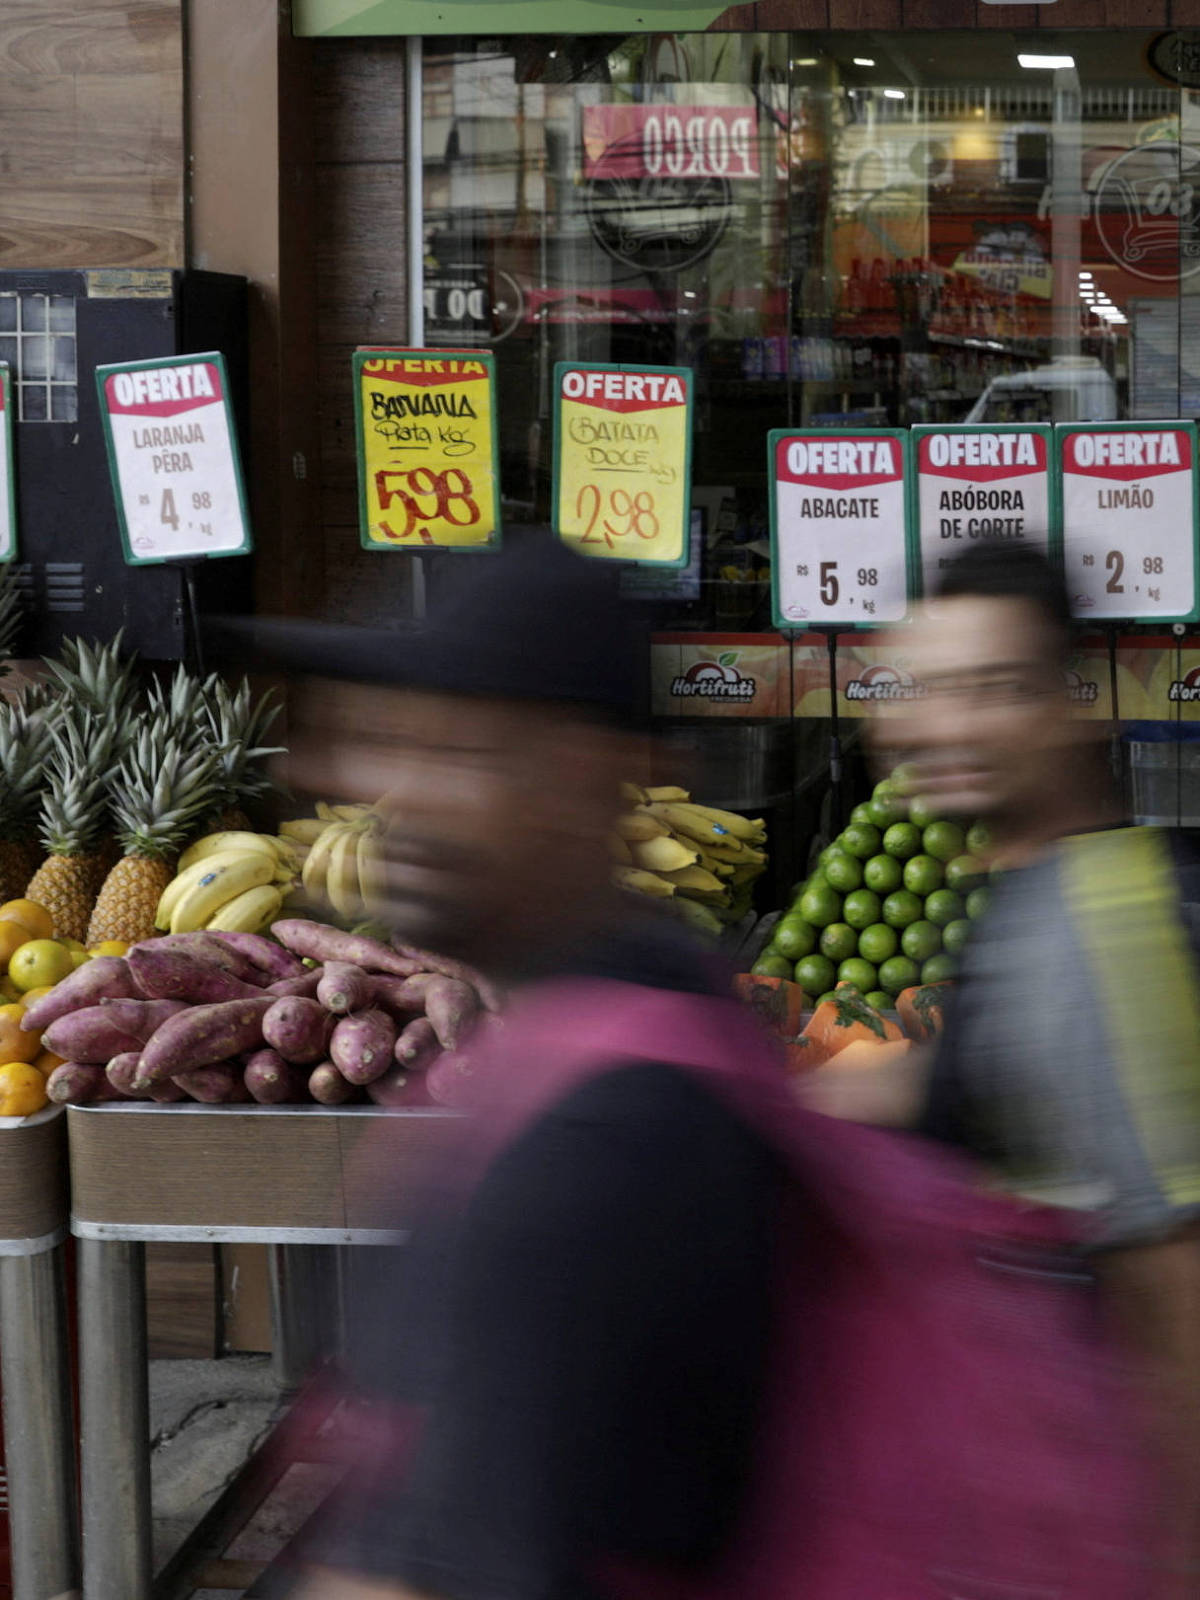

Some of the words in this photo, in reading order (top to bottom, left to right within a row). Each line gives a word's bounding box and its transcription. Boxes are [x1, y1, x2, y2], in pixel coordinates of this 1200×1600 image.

[1150, 182, 1194, 216] 03
[114, 364, 214, 407] OFERTA
[562, 372, 684, 402] OFERTA
[370, 392, 477, 420] BANANA
[132, 423, 204, 449] LARANJA
[569, 417, 660, 444] BATATA
[152, 450, 193, 474] PÊRA
[586, 447, 649, 466] DOCE
[787, 442, 895, 475] OFERTA
[929, 433, 1038, 466] OFERTA
[1074, 432, 1180, 467] OFERTA
[801, 498, 879, 519] ABACATE
[940, 485, 1024, 510] ABÓBORA
[1098, 484, 1154, 509] LIMÃO
[576, 484, 659, 550] 2,98
[940, 518, 962, 538] DE
[968, 518, 1024, 538] CORTE
[672, 680, 754, 696] Hortifruti
